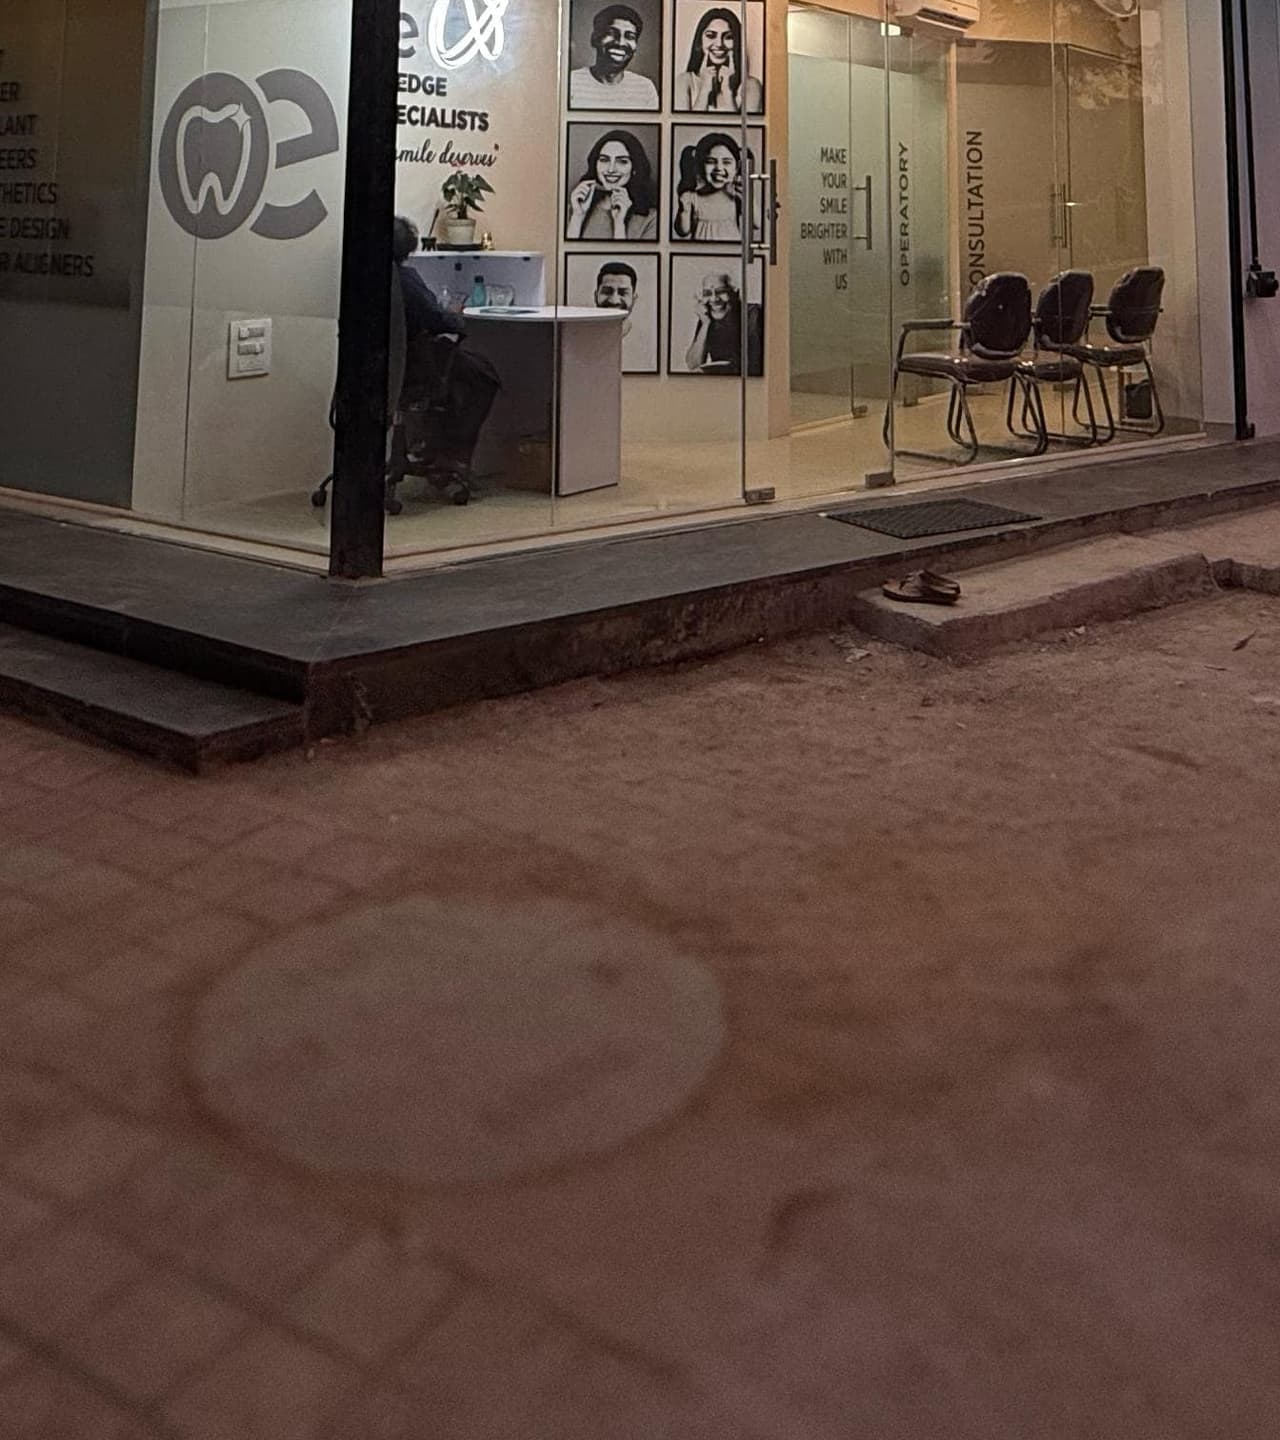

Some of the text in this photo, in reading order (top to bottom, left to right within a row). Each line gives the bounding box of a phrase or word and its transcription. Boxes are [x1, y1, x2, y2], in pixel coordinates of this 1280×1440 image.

[397, 72, 447, 97] EDGE
[396, 105, 489, 132] ECIALISTS
[395, 138, 436, 164] mile
[820, 148, 846, 164] MAKE
[822, 173, 846, 189] YOUR
[820, 198, 847, 214] SMILE
[898, 142, 910, 287] OPERATORY
[966, 130, 985, 289] ONSULTATION
[9, 217, 71, 240] DESIGN
[800, 222, 847, 239] BRIGHTER
[823, 248, 847, 264] WITH
[835, 274, 847, 289] US
